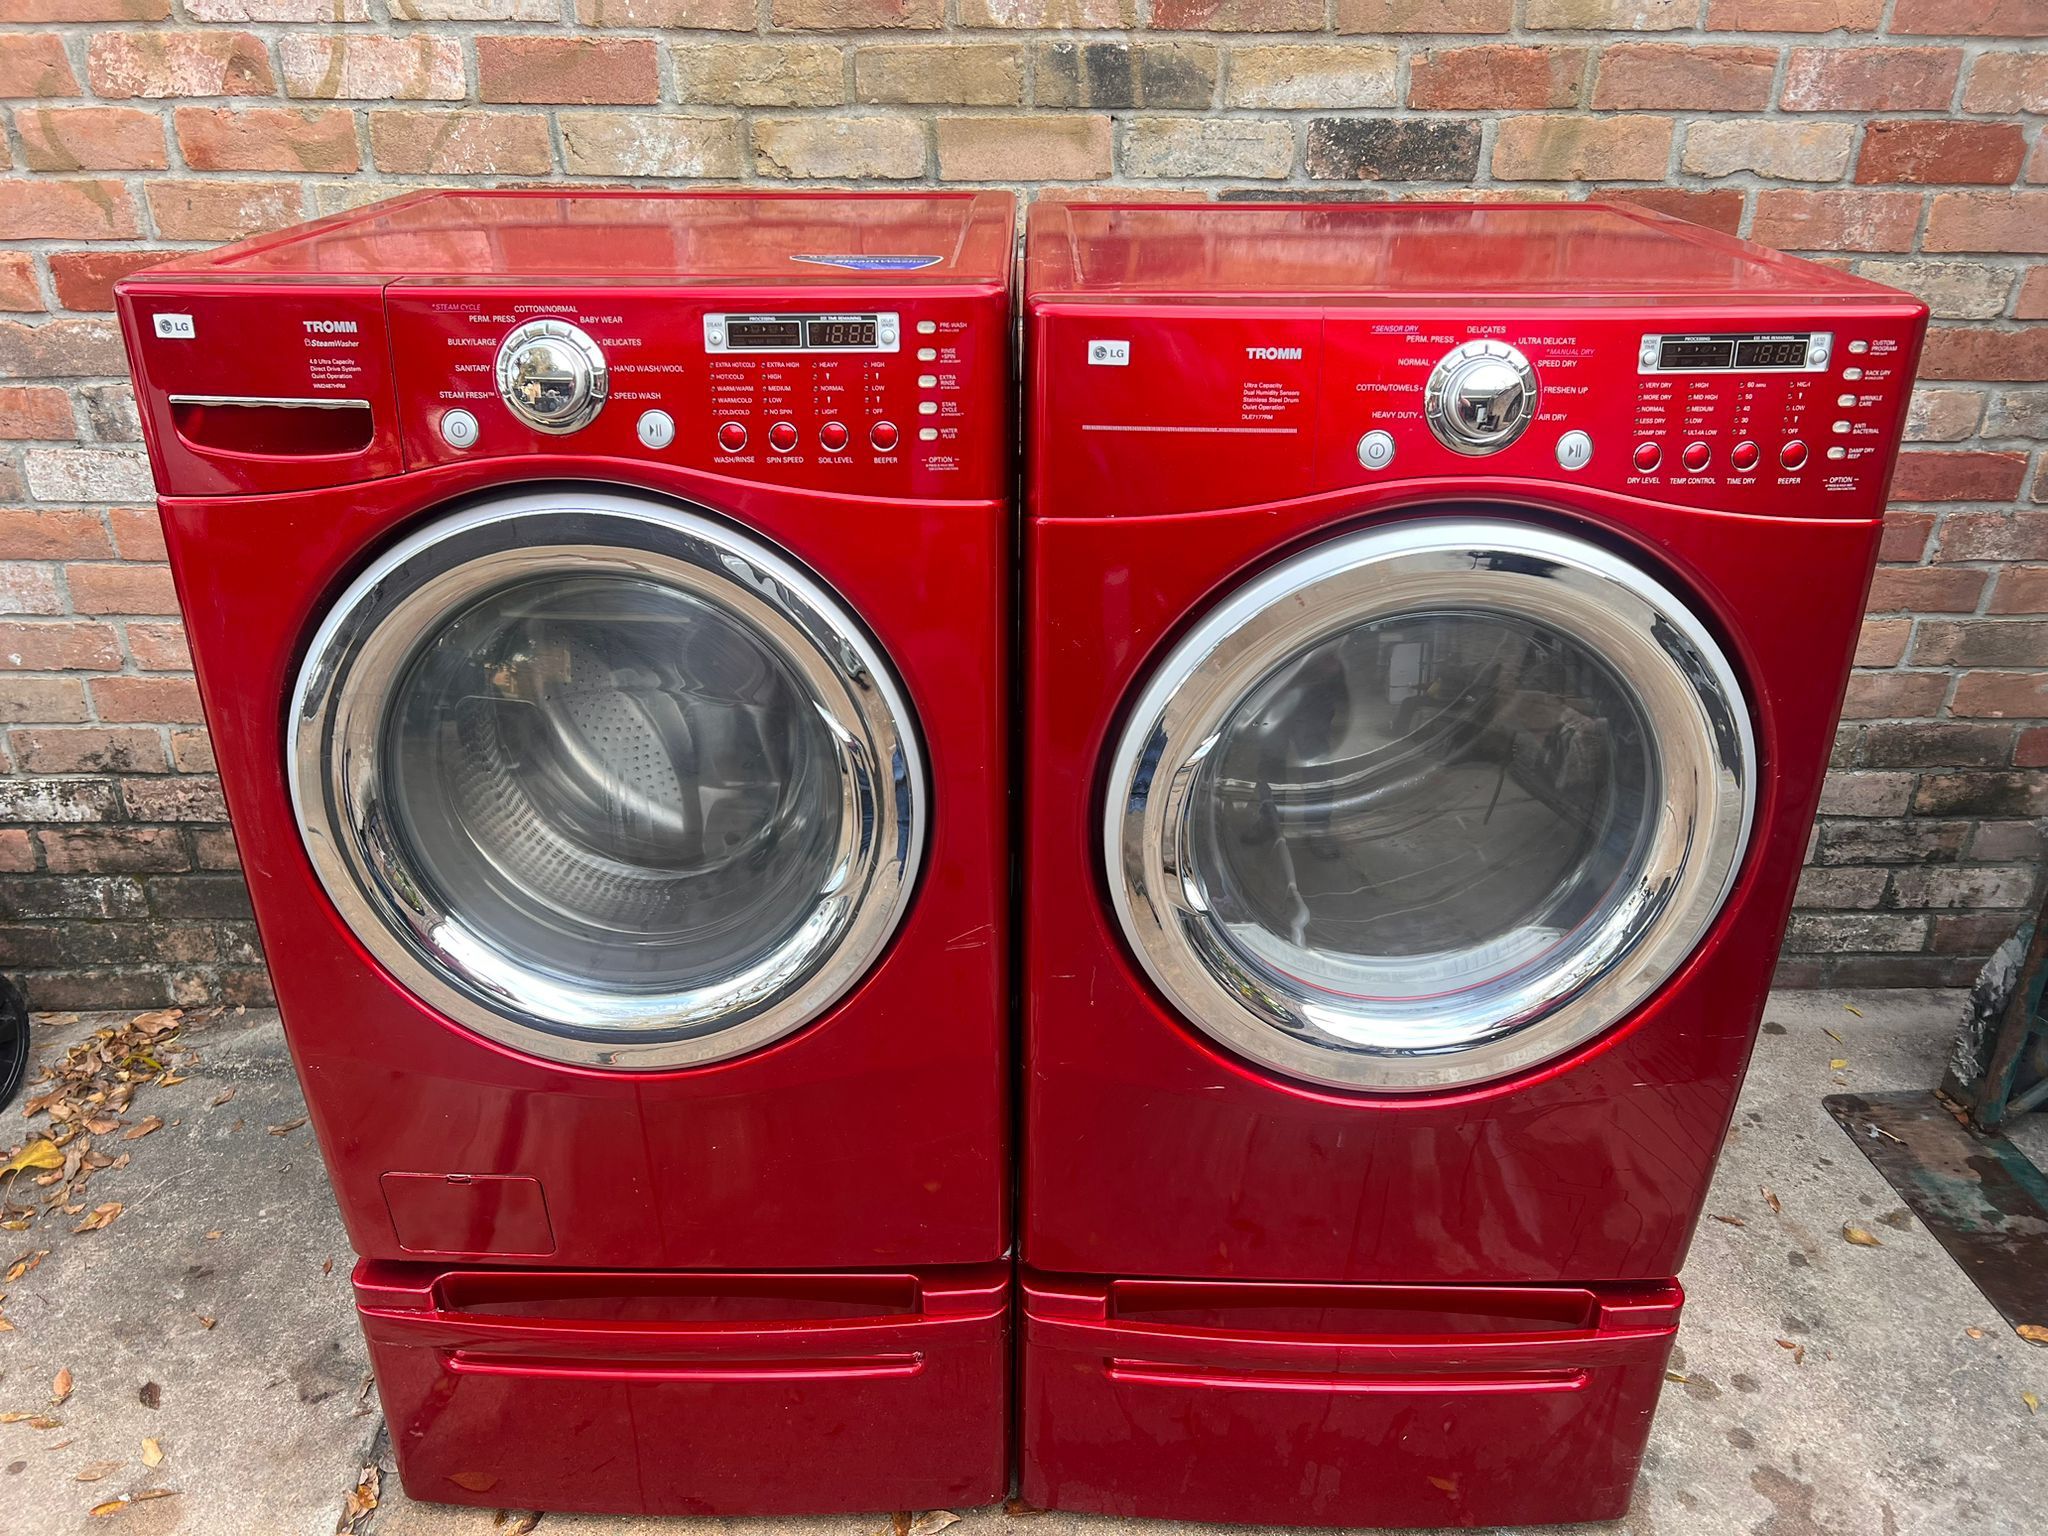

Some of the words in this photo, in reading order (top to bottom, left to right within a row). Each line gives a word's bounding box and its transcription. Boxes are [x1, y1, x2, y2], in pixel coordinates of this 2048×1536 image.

[460, 303, 481, 311] CYCLE
[174, 322, 190, 332] LG
[303, 321, 357, 332] TROMM
[1543, 337, 1576, 345] DELICATE
[1109, 348, 1125, 359] LG
[1246, 348, 1302, 359] TROMM
[332, 358, 354, 366] Capacity
[1259, 382, 1282, 390] Capacity
[1256, 389, 1279, 397] Humidity
